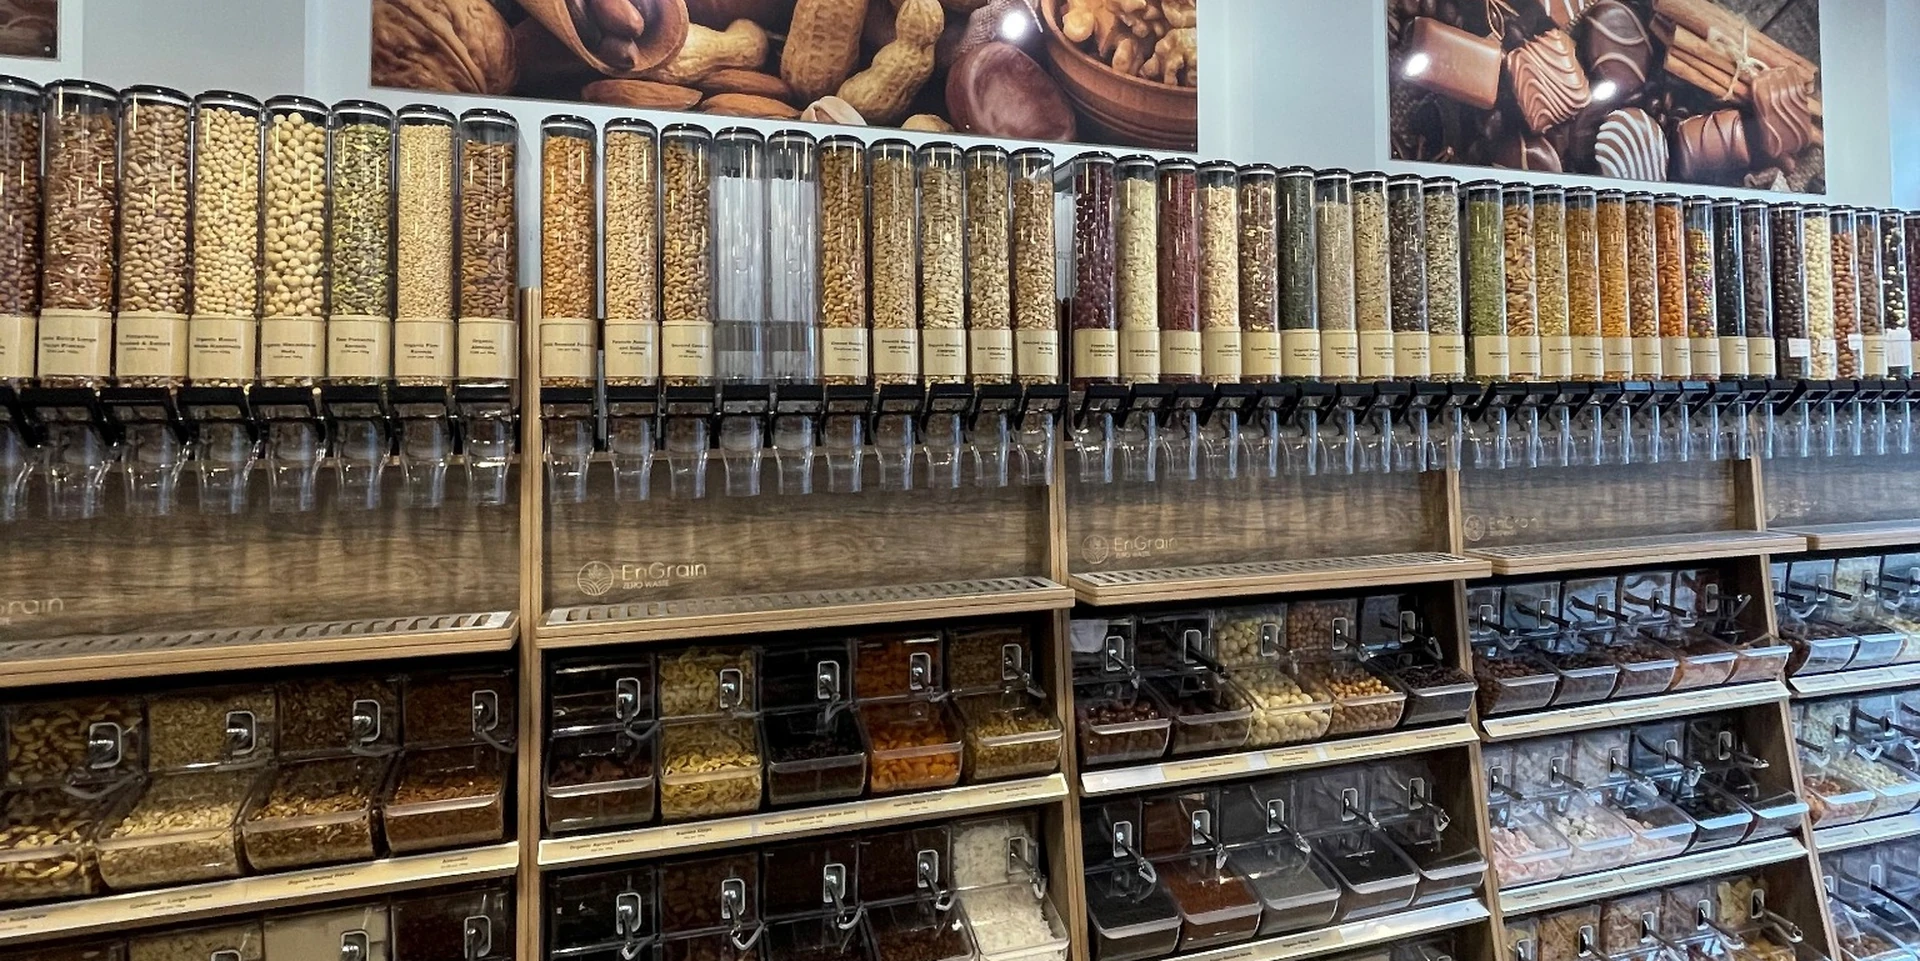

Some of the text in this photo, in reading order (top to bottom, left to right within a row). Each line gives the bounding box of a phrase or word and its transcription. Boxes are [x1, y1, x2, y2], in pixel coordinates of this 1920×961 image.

[1114, 535, 1178, 552] EnGrain
[622, 562, 707, 581] EnGrain
[622, 579, 669, 589] ZERO WASTE
[0, 598, 64, 615] rain
